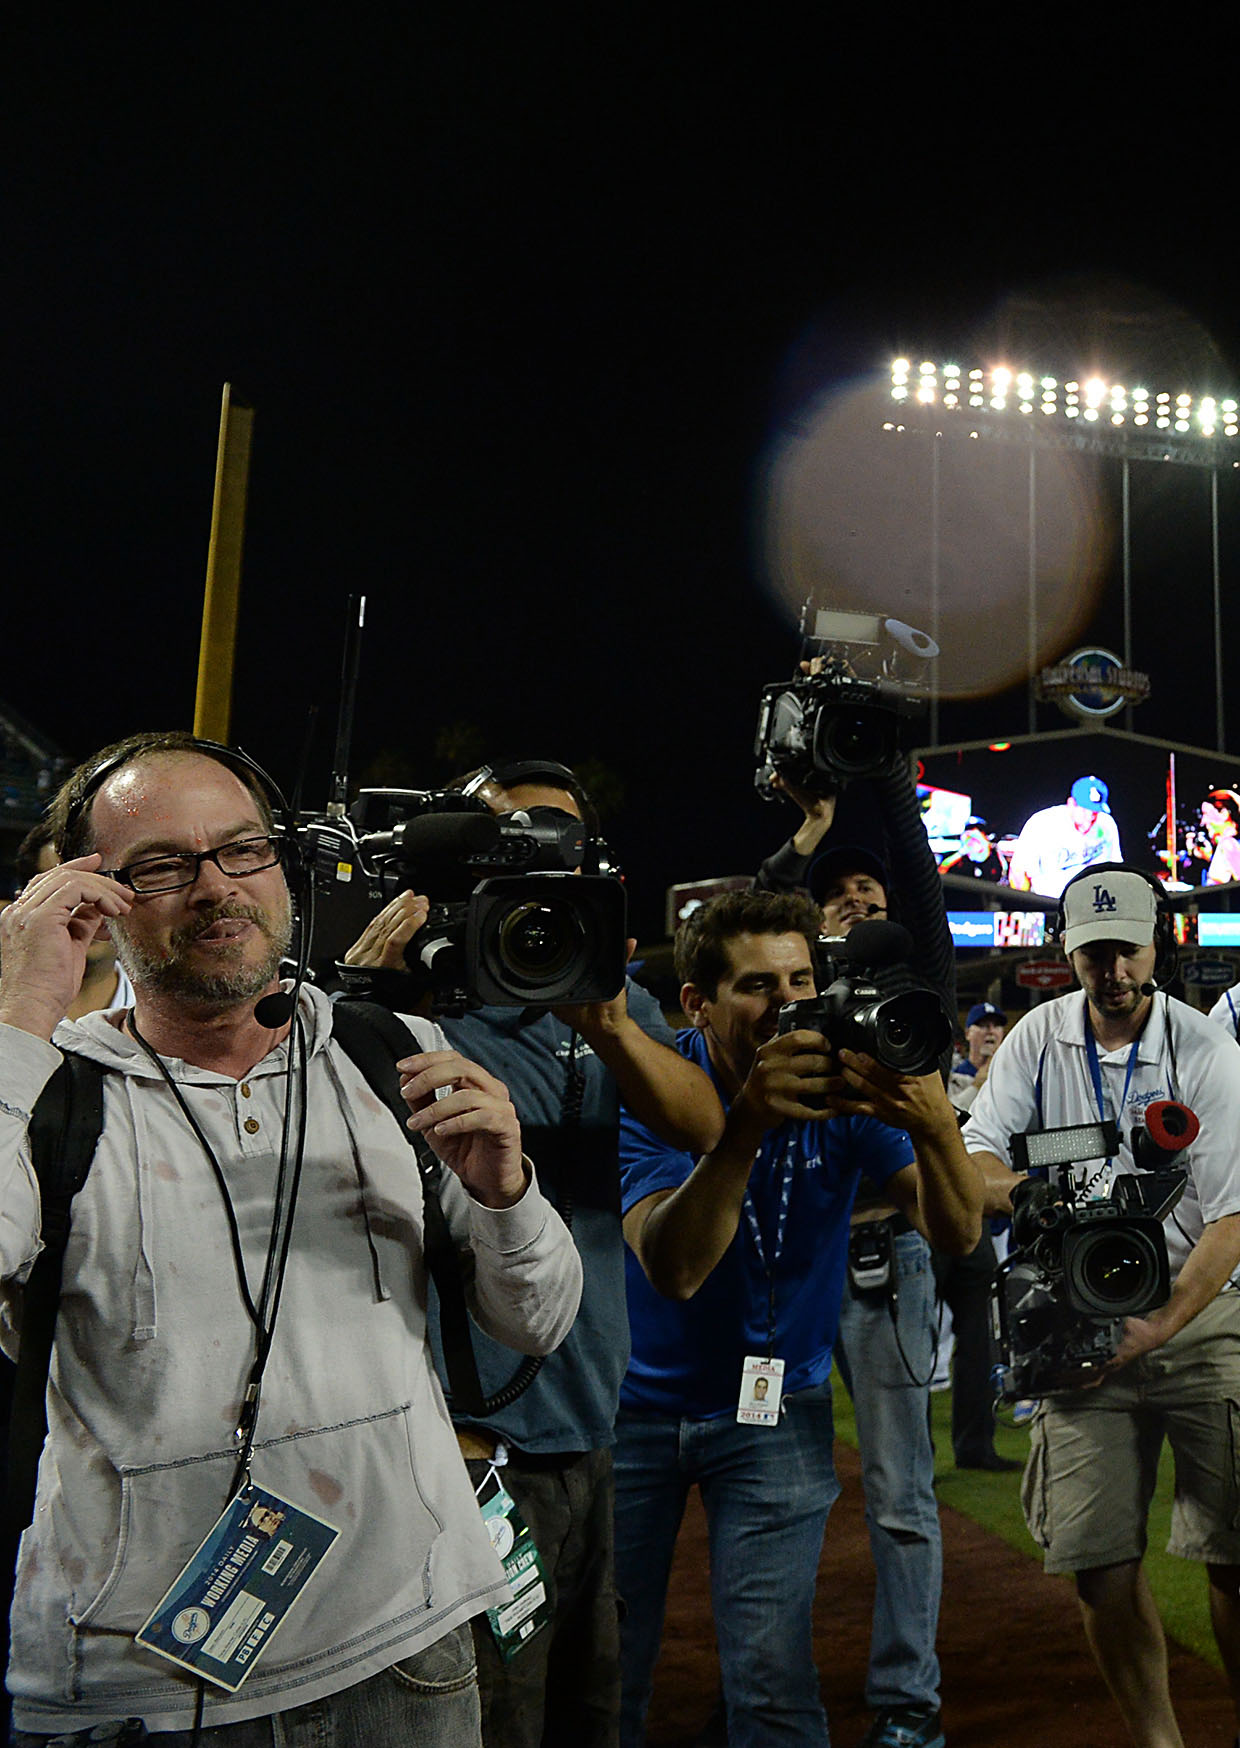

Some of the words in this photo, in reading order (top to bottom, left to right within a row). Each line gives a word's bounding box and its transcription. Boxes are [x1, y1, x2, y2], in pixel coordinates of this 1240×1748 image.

[1092, 884, 1117, 913] LA
[854, 988, 877, 996] Canon
[1127, 1086, 1165, 1107] Dodgers
[751, 1364, 776, 1373] MEDIA
[200, 1563, 239, 1608] WORKING
[230, 1534, 260, 1567] MEDIA
[204, 1568, 220, 1586] 2014
[217, 1545, 235, 1567] DAILY
